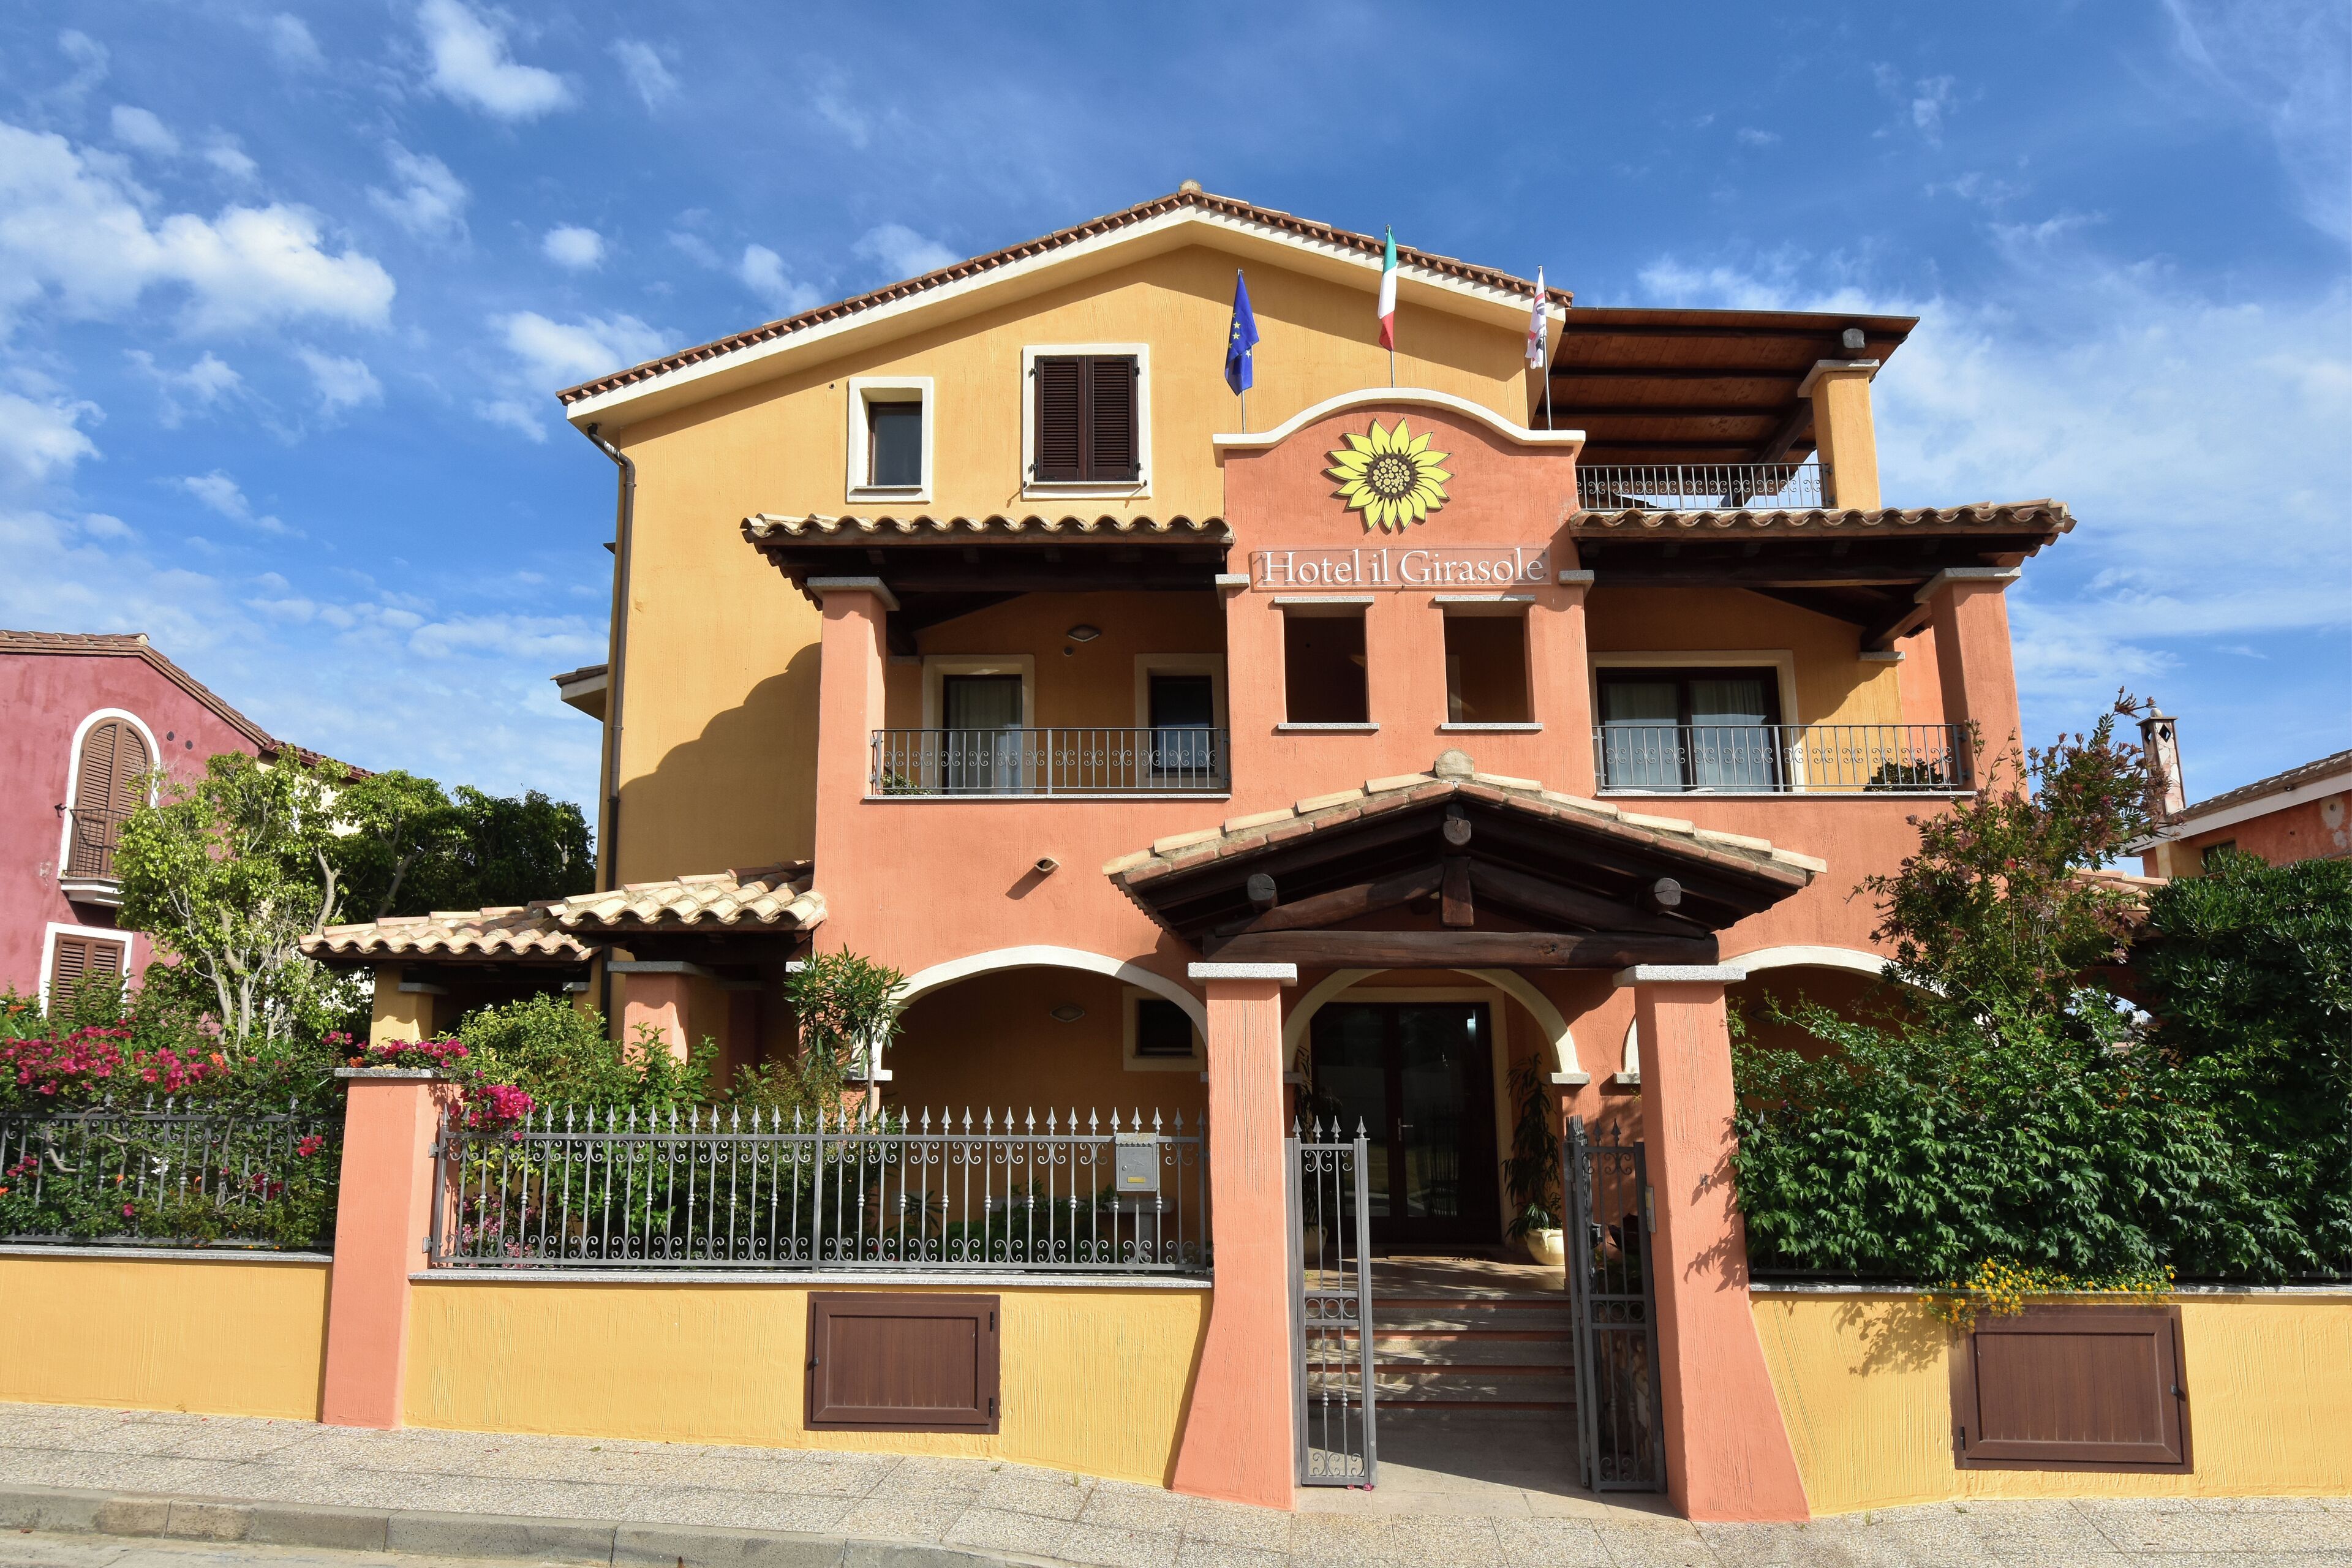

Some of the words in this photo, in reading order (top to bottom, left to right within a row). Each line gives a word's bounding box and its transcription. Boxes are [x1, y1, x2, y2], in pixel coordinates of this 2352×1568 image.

[1263, 549, 1361, 582] Hotel
[1371, 549, 1391, 582] il
[1400, 548, 1544, 582] Girasole
